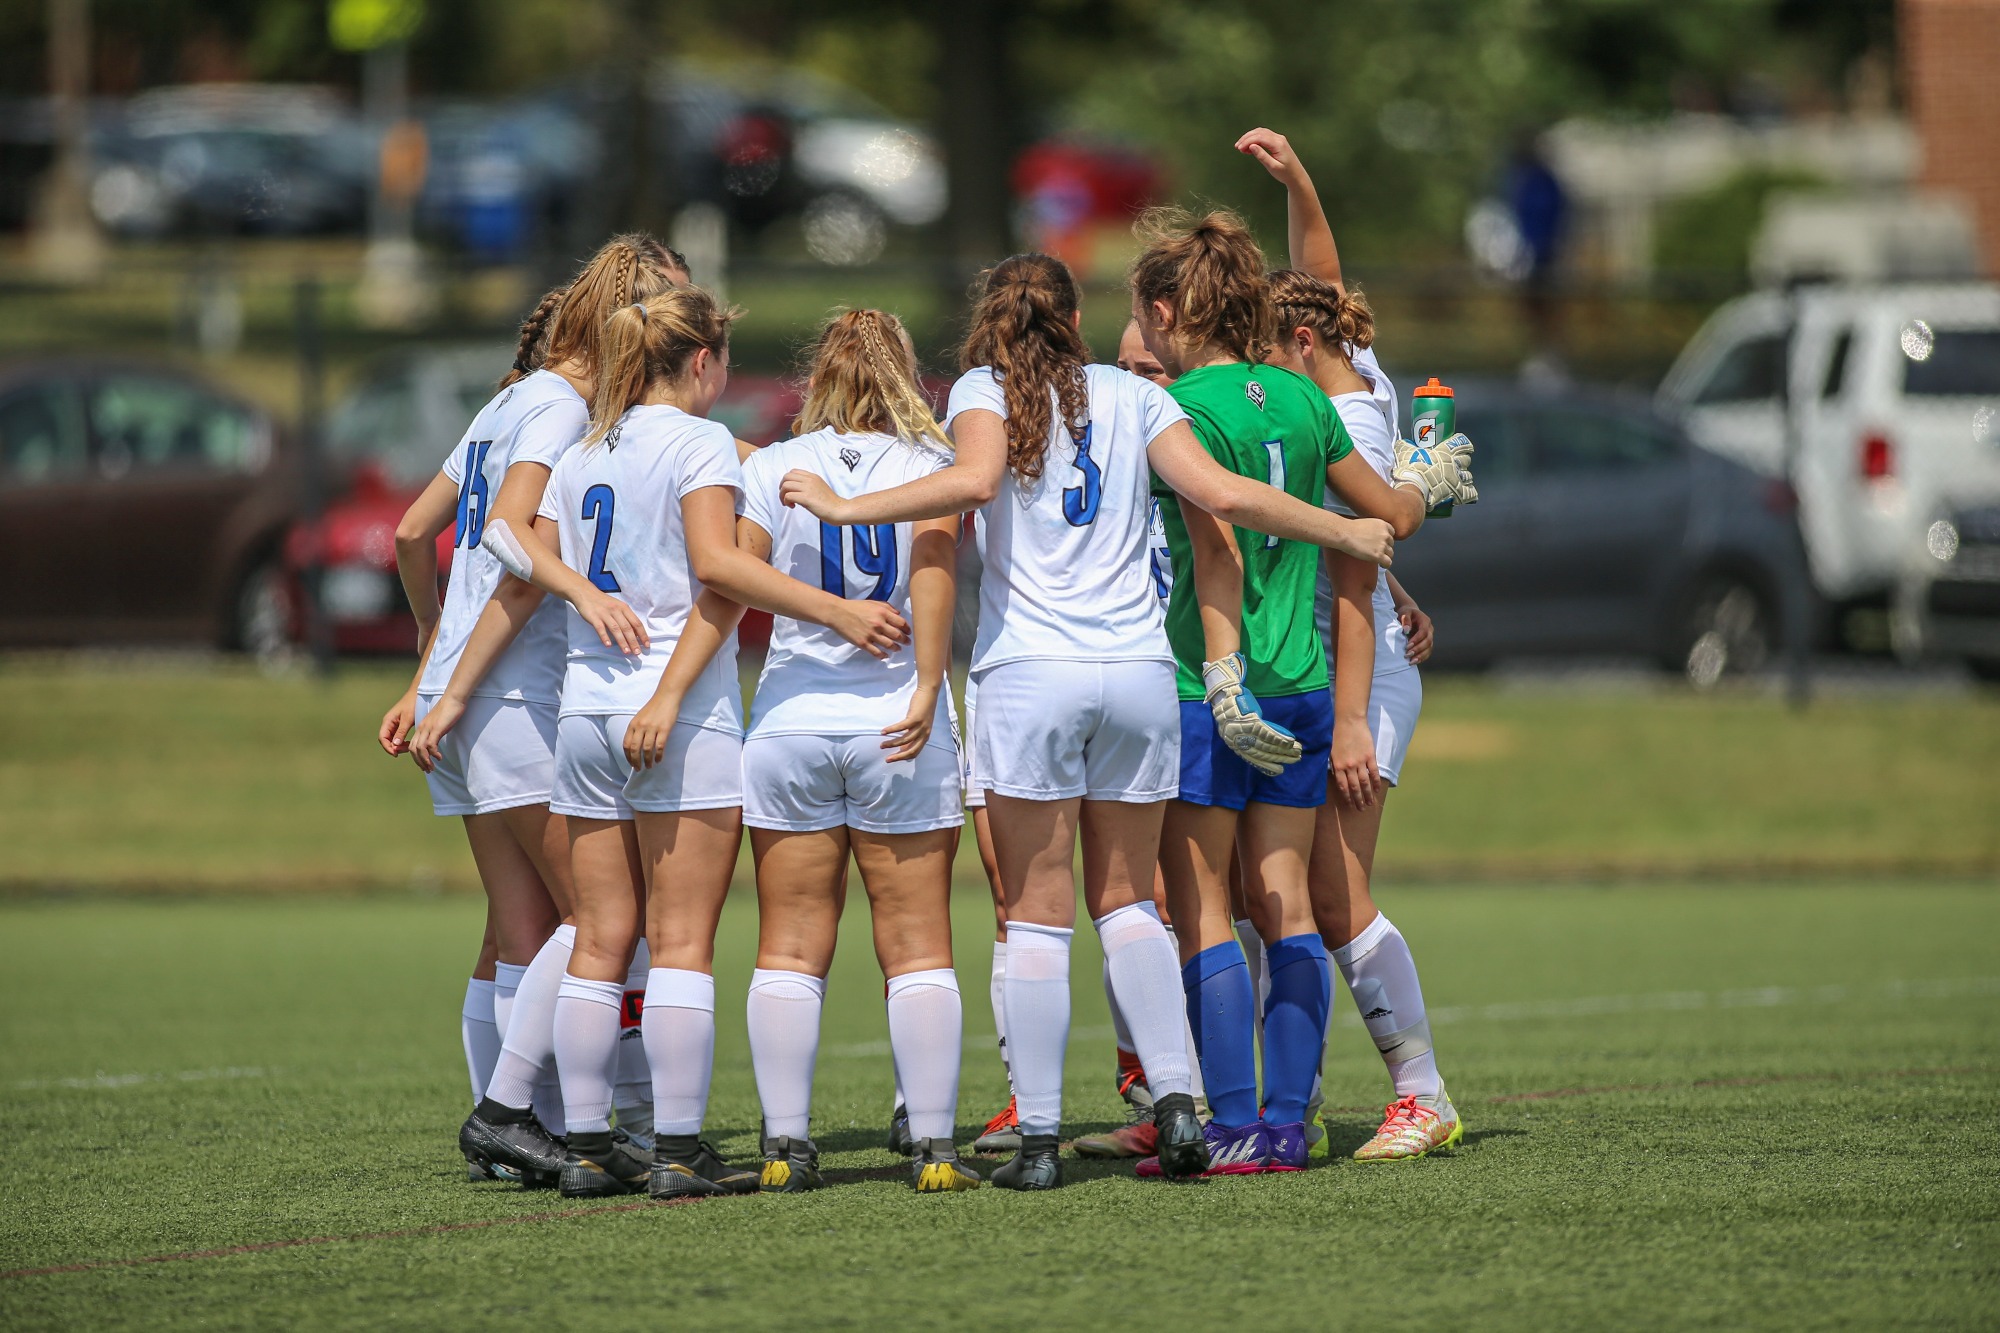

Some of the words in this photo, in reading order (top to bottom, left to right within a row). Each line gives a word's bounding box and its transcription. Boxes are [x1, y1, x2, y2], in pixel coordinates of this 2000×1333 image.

[1062, 420, 1102, 528] 3
[1260, 438, 1287, 550] 1
[581, 483, 621, 593] 2
[819, 519, 899, 601] 19
